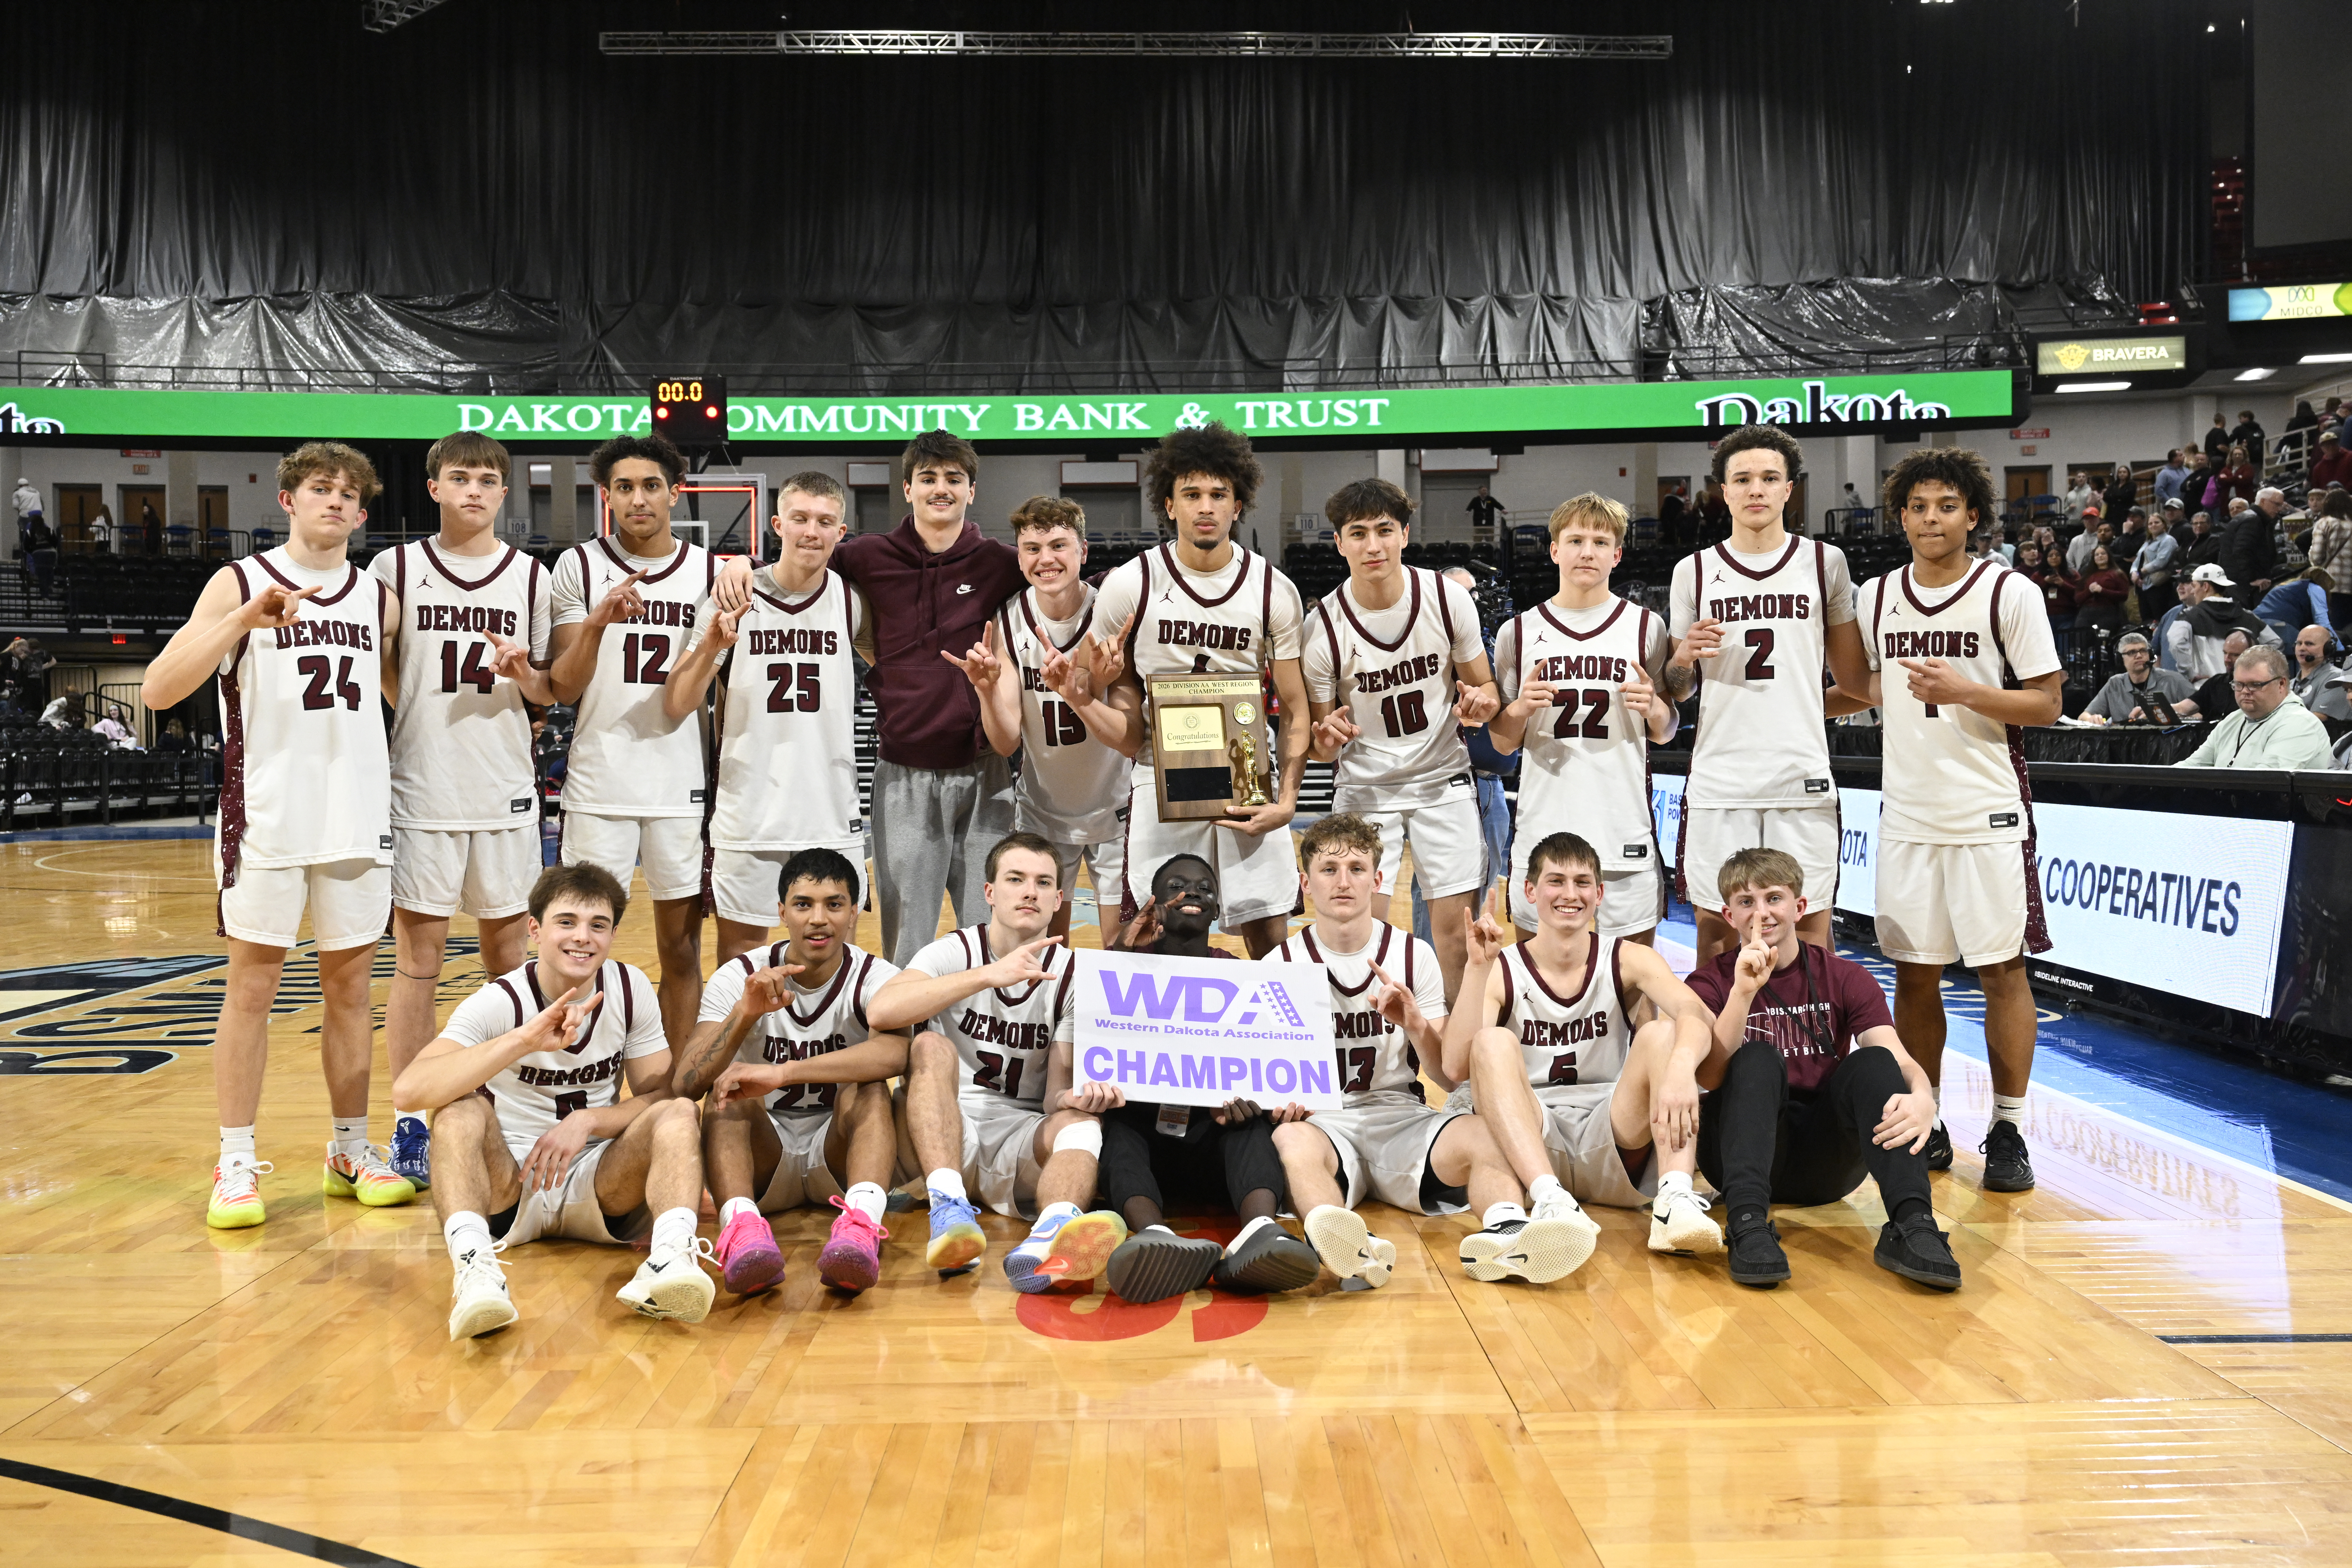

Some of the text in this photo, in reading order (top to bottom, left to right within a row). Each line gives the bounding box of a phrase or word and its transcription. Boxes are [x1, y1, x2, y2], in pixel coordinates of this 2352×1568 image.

[2281, 305, 2322, 316] MIDCO
[2093, 346, 2169, 362] BRAVERA
[658, 382, 702, 402] 00.0
[457, 398, 1390, 433] DAKOTA OMMUNITY BANK & TRUST
[512, 523, 526, 533] 108
[1301, 519, 1313, 529] 110
[417, 605, 517, 637] DEMONS
[612, 600, 695, 629] MONS
[1710, 594, 1810, 623] DEMONS
[275, 620, 373, 652] DEMONS
[749, 628, 838, 656] DEMONS
[1158, 619, 1251, 651] DEMONS
[1884, 631, 1979, 659] DEMONS
[440, 640, 495, 694] 14
[623, 632, 670, 685] 12
[1535, 655, 1627, 683] DEMONS
[1744, 628, 1775, 680] 2
[297, 654, 361, 712] 24
[766, 662, 820, 713] 25
[1354, 653, 1439, 693] DEMONS
[1042, 700, 1087, 747] 15
[1381, 689, 1429, 738] 10
[1552, 688, 1609, 740] 22
[1167, 732, 1219, 741] Congratulations
[1668, 808, 1681, 820] POW
[1669, 793, 1682, 806] BAS
[1842, 828, 1867, 868] OTA
[2046, 857, 2241, 937] COOPERATIVES
[2037, 971, 2094, 992] SIDELINE INTERACTIVE
[1098, 969, 1306, 1027] WDA
[1809, 1002, 1830, 1012] HGH
[958, 1007, 1049, 1050] DEMONS
[1095, 1018, 1314, 1041] Western Dakota Association
[1332, 1010, 1395, 1038] MONS
[1520, 1010, 1608, 1046] DEMONS
[763, 1033, 847, 1064] DEMONS
[517, 1050, 622, 1086] DEMONS
[973, 1050, 1024, 1099] 21
[1083, 1046, 1331, 1094] CHAMPION
[1336, 1046, 1377, 1094] 13
[1548, 1051, 1578, 1085] 5
